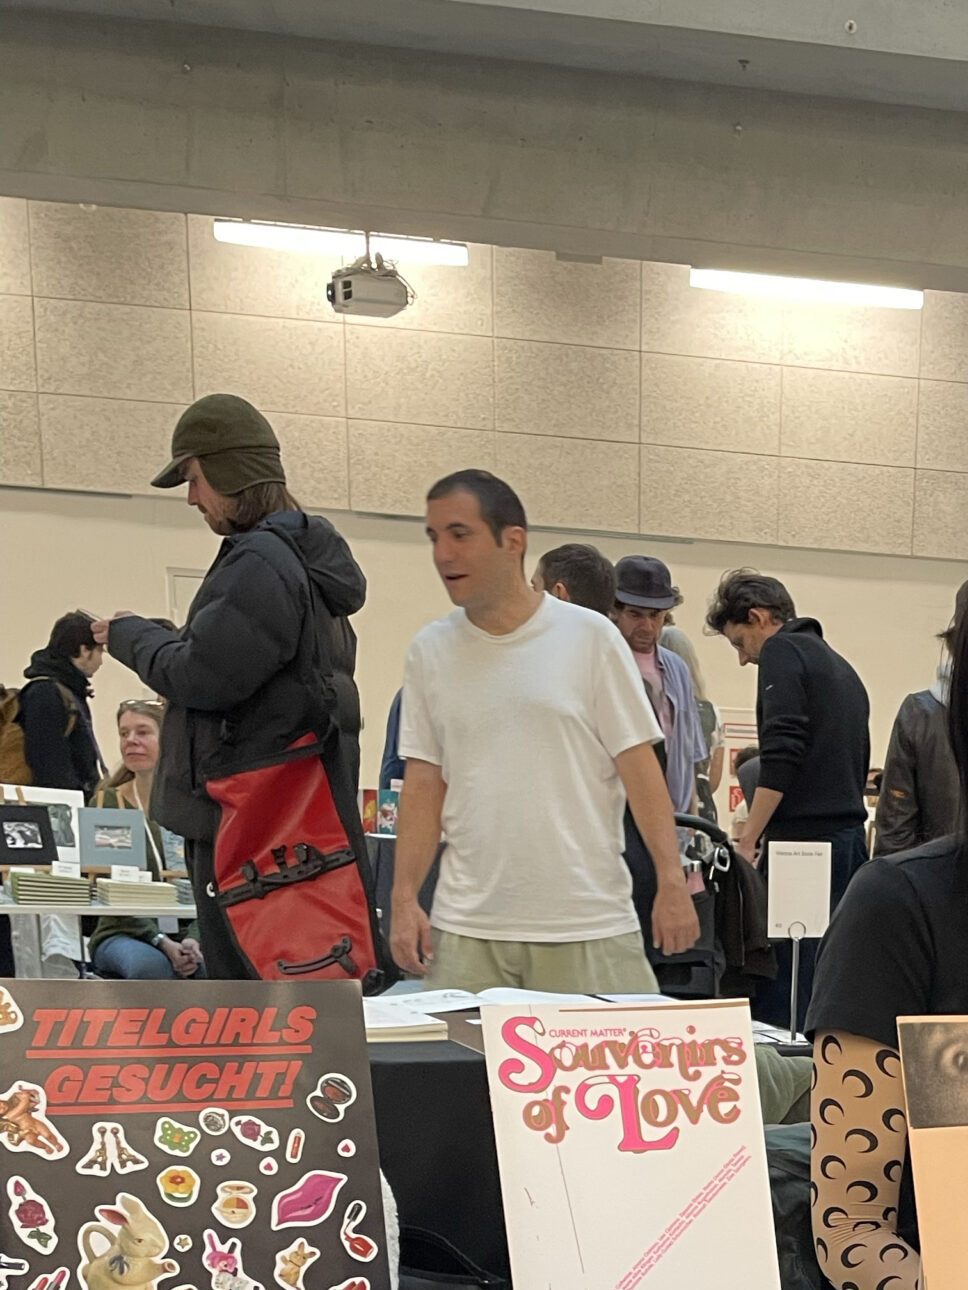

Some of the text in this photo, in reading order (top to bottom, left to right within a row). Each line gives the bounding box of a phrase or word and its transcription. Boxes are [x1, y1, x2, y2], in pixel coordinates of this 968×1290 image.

[32, 1006, 318, 1046] TITELGIRLS
[549, 1029, 587, 1038] CURRENT
[498, 1016, 747, 1093] Souvenirs
[44, 1060, 303, 1104] GESUCHT!
[523, 1070, 741, 1153] of Love
